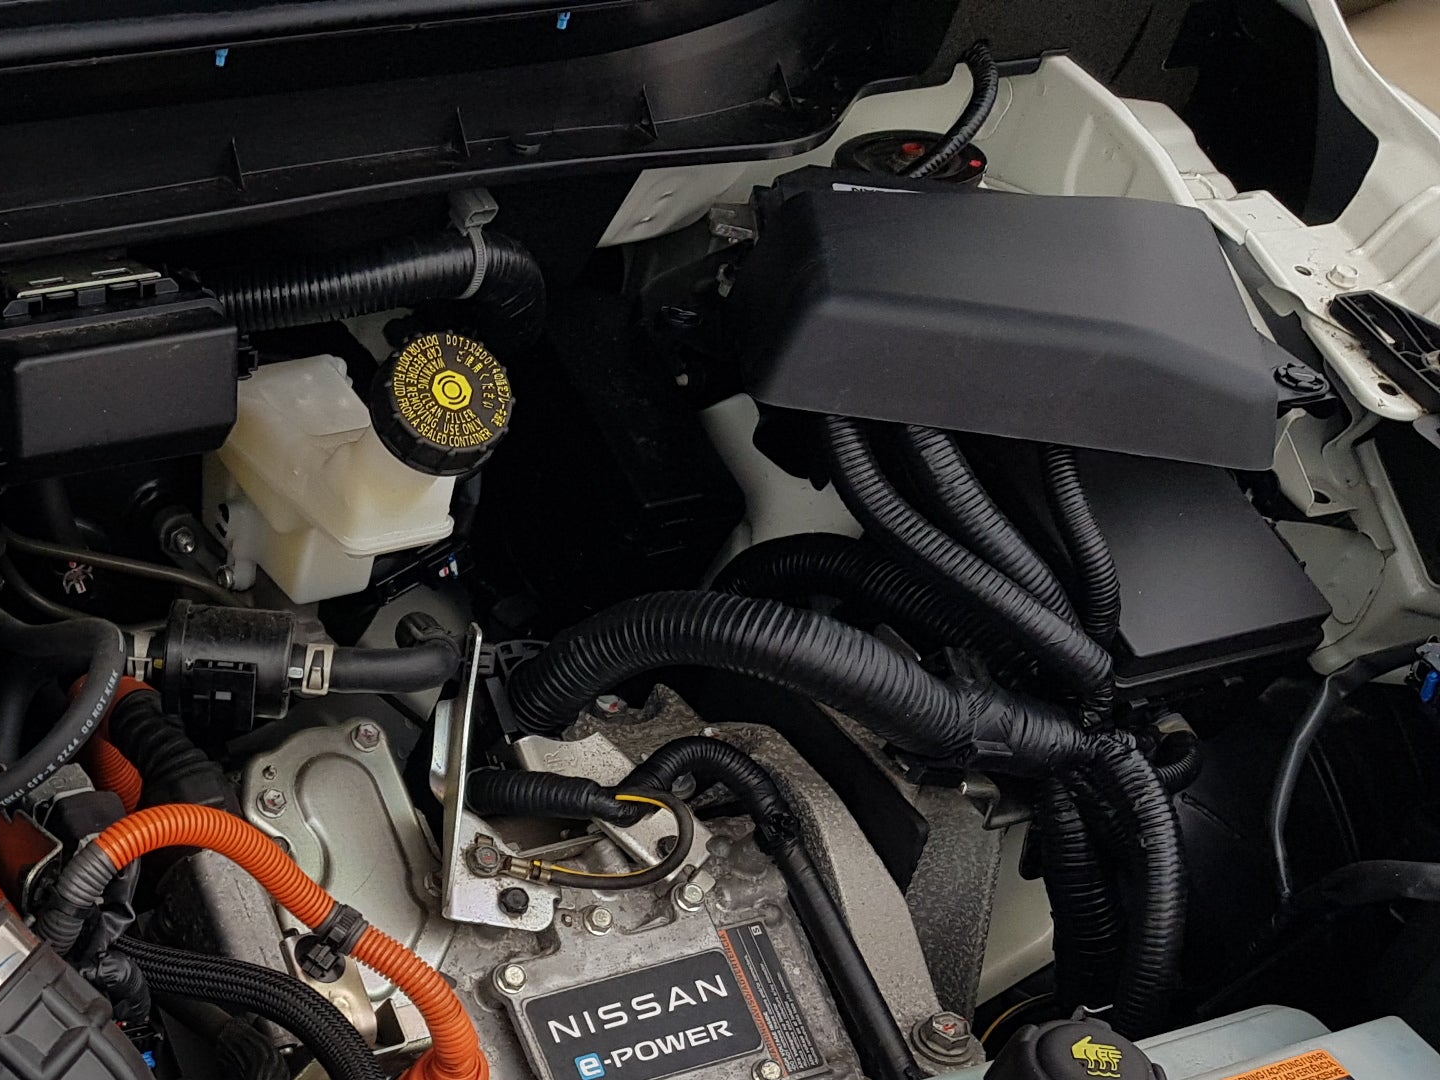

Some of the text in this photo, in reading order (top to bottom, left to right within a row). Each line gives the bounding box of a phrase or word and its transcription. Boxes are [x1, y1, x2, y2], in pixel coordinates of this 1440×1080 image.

[406, 343, 420, 356] OR
[426, 346, 442, 360] CAP
[406, 354, 428, 384] BEFORE
[393, 372, 406, 396] FLUID
[418, 358, 477, 423] WARNING CLEAN FILLER
[397, 397, 417, 420] FROM
[410, 419, 420, 428] A
[417, 423, 447, 445] SEALED
[443, 423, 460, 435] USE
[462, 417, 484, 435] ONLY
[448, 428, 494, 448] CONTAINER
[81, 719, 94, 735] DO
[91, 695, 107, 719] NOT
[547, 974, 728, 1044] NISSAN
[575, 1020, 734, 1080] e-POWER
[1265, 1059, 1302, 1078] ACHTUNG
